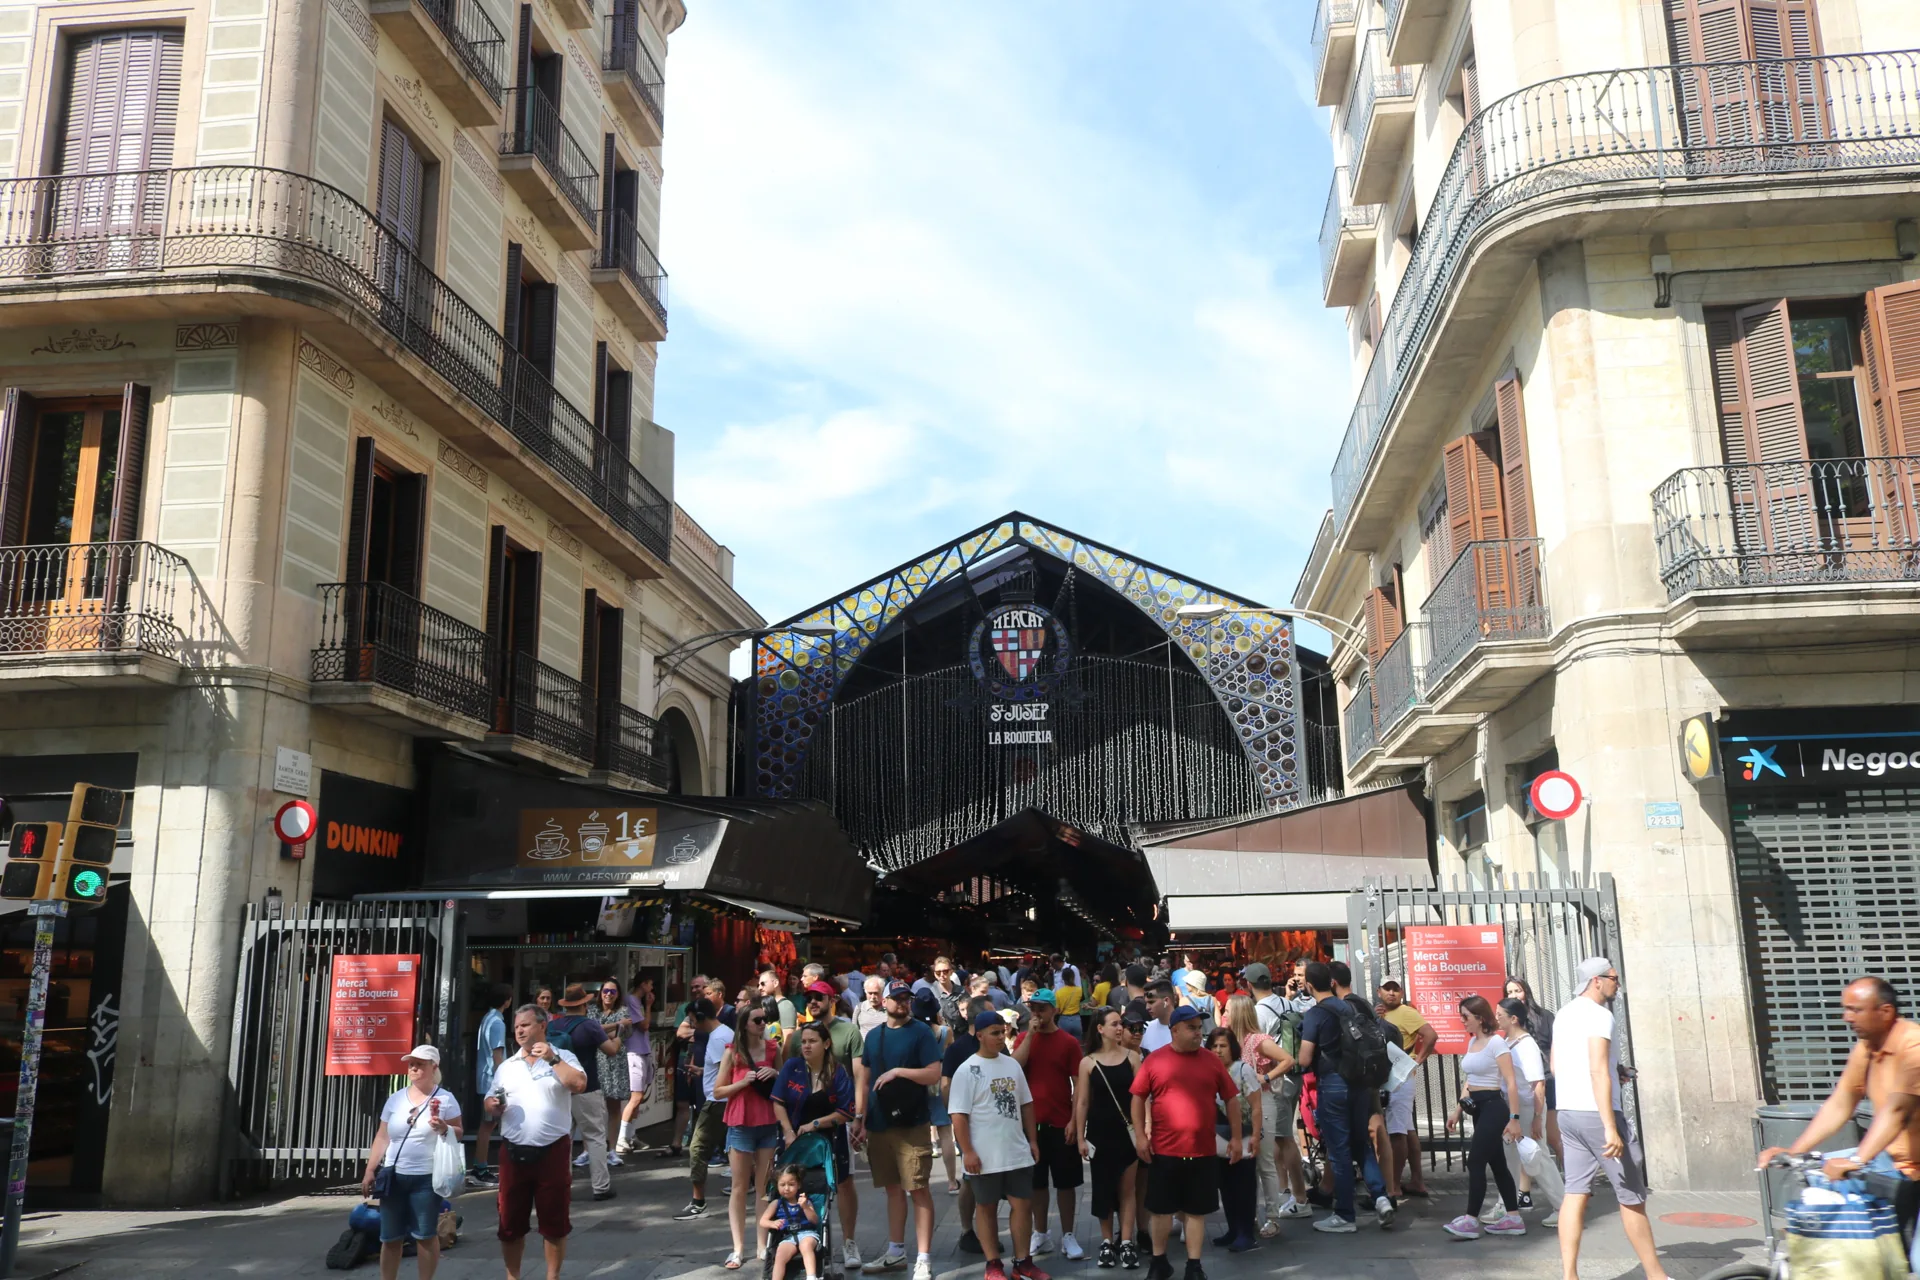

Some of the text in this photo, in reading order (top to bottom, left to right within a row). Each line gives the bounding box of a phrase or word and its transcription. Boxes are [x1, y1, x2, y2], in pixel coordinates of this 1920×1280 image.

[993, 610, 1044, 629] MERCAT
[1004, 703, 1049, 721] JOSEP
[989, 730, 1052, 744] LA BOQUERIA
[616, 811, 650, 842] 1€
[1651, 816, 1677, 826] 2251
[1413, 951, 1449, 961] Mercat
[1414, 961, 1486, 973] de la Boqueria
[337, 979, 368, 987] Mercat
[336, 988, 398, 999] de la Boqueria
